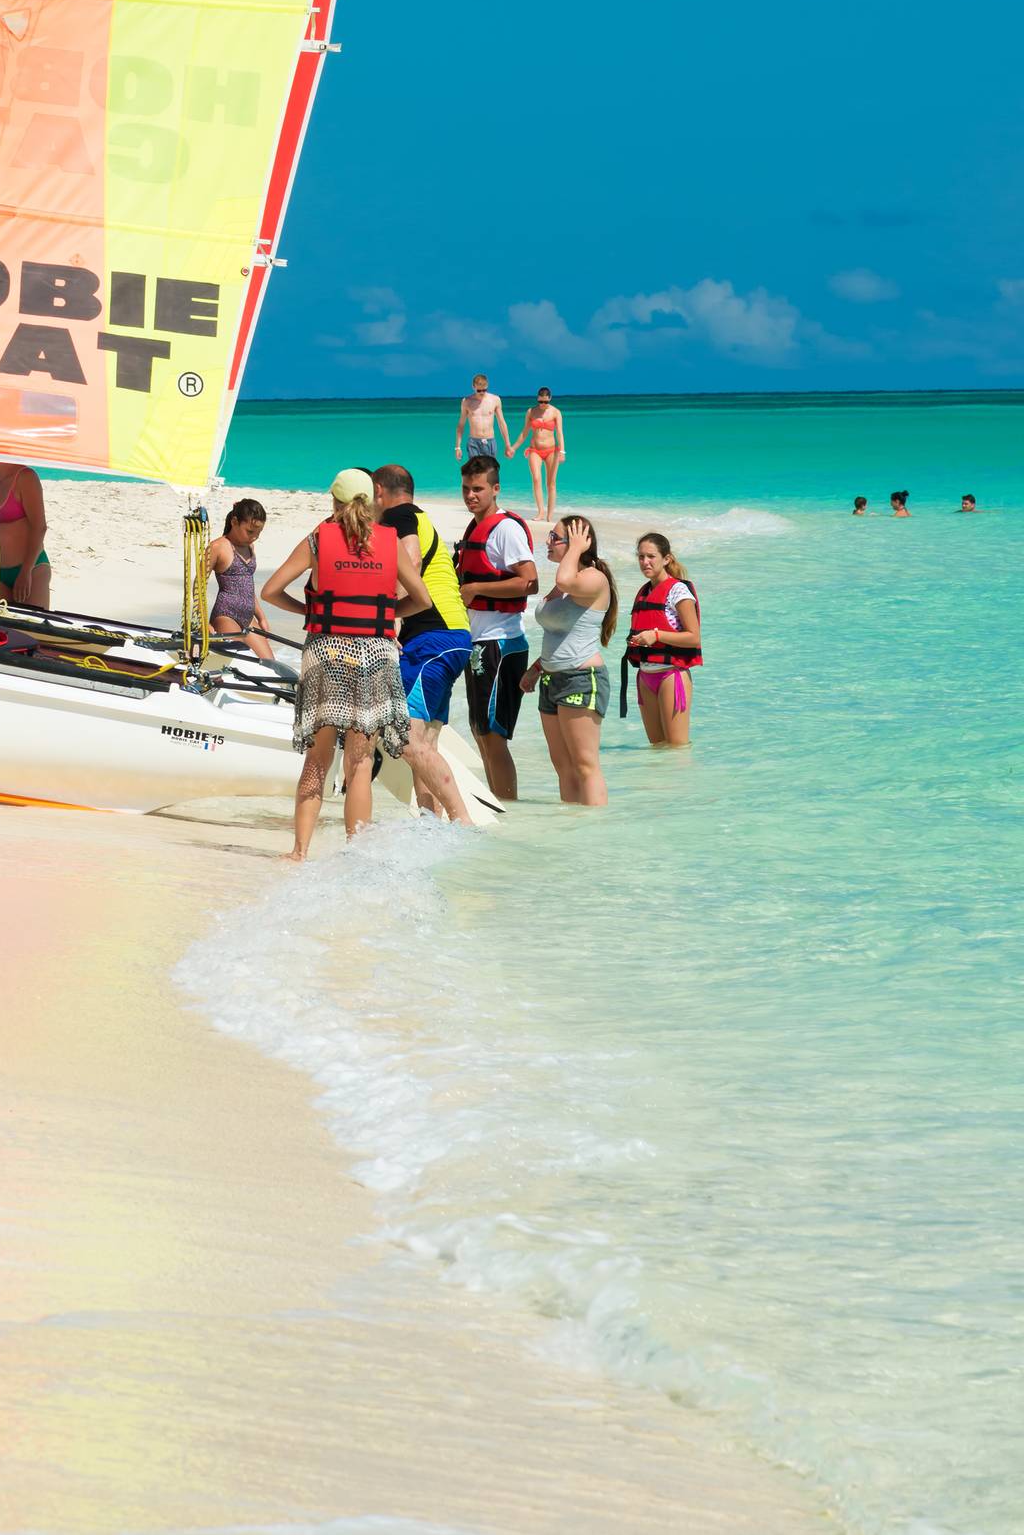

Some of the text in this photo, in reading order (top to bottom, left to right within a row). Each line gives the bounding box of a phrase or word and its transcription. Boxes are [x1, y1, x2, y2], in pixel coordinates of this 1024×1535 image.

[334, 560, 383, 571] gaviota
[161, 725, 210, 742] HOBIE
[212, 734, 225, 745] 15
